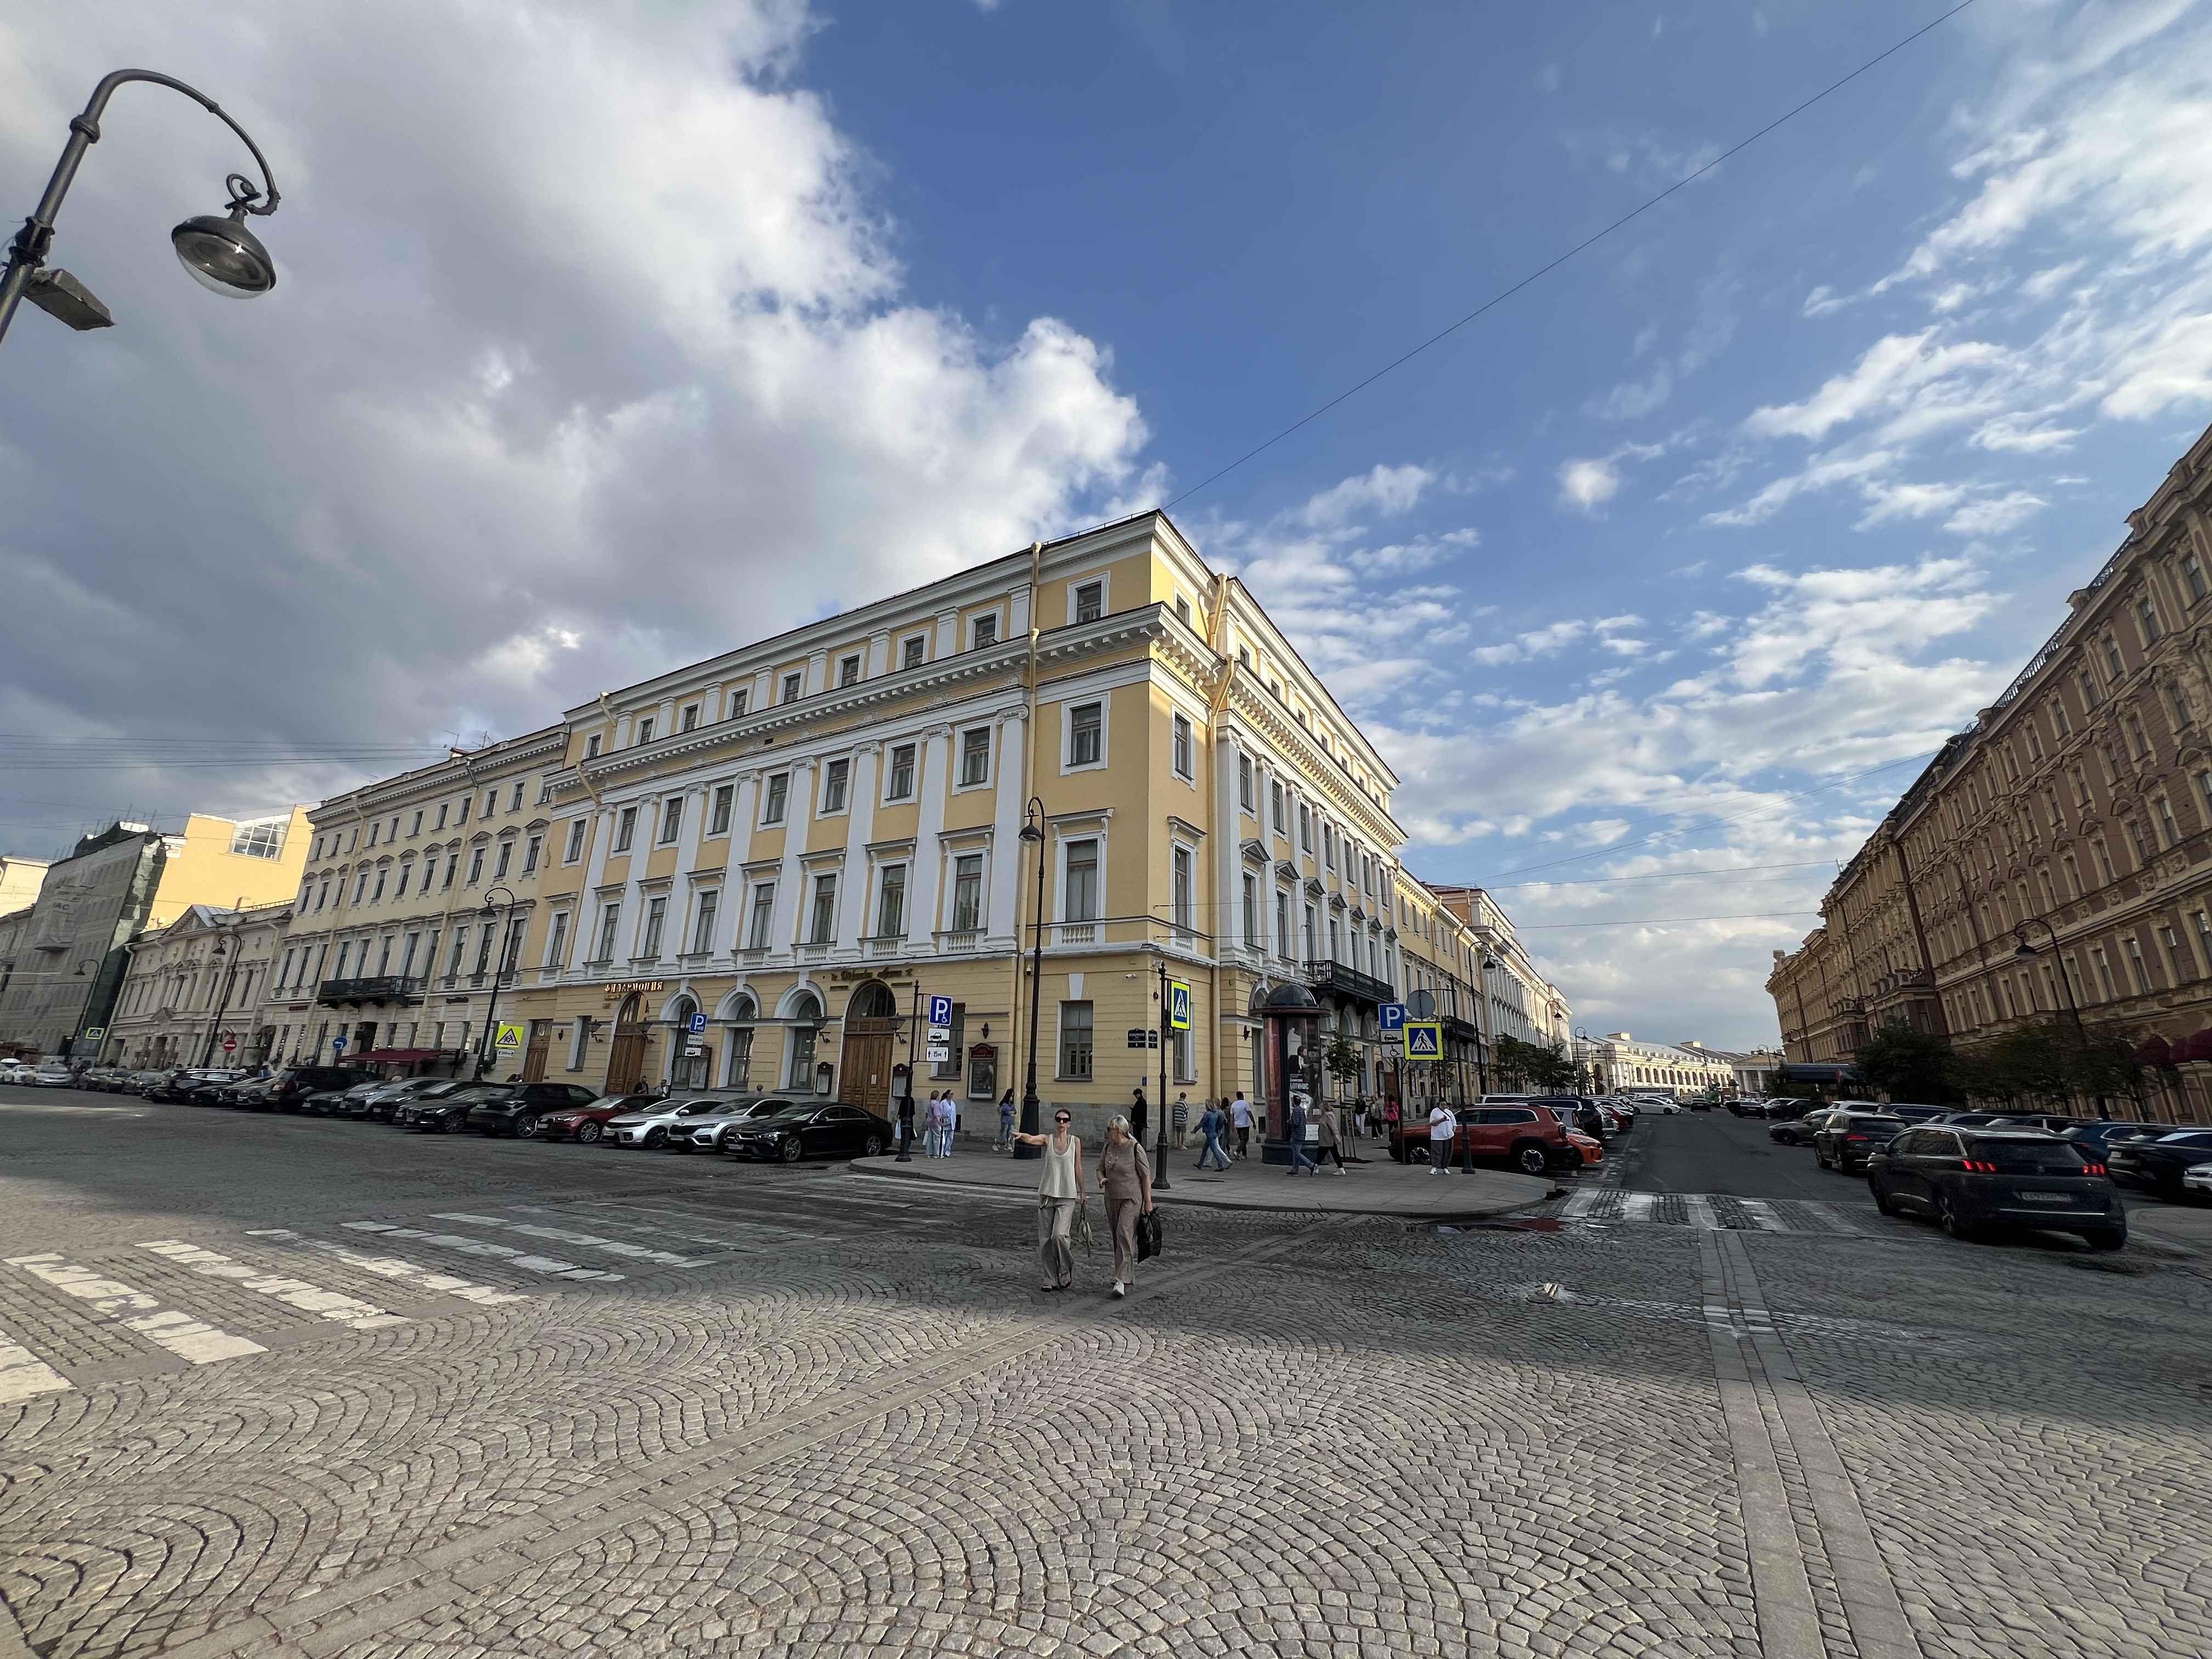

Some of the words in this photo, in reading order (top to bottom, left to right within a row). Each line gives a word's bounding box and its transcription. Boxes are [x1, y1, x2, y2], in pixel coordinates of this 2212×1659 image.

[605, 981, 663, 992] ФИЛАРМОНИЯ
[935, 999, 948, 1021] P
[1386, 1007, 1400, 1027] P
[694, 1015, 704, 1030] P
